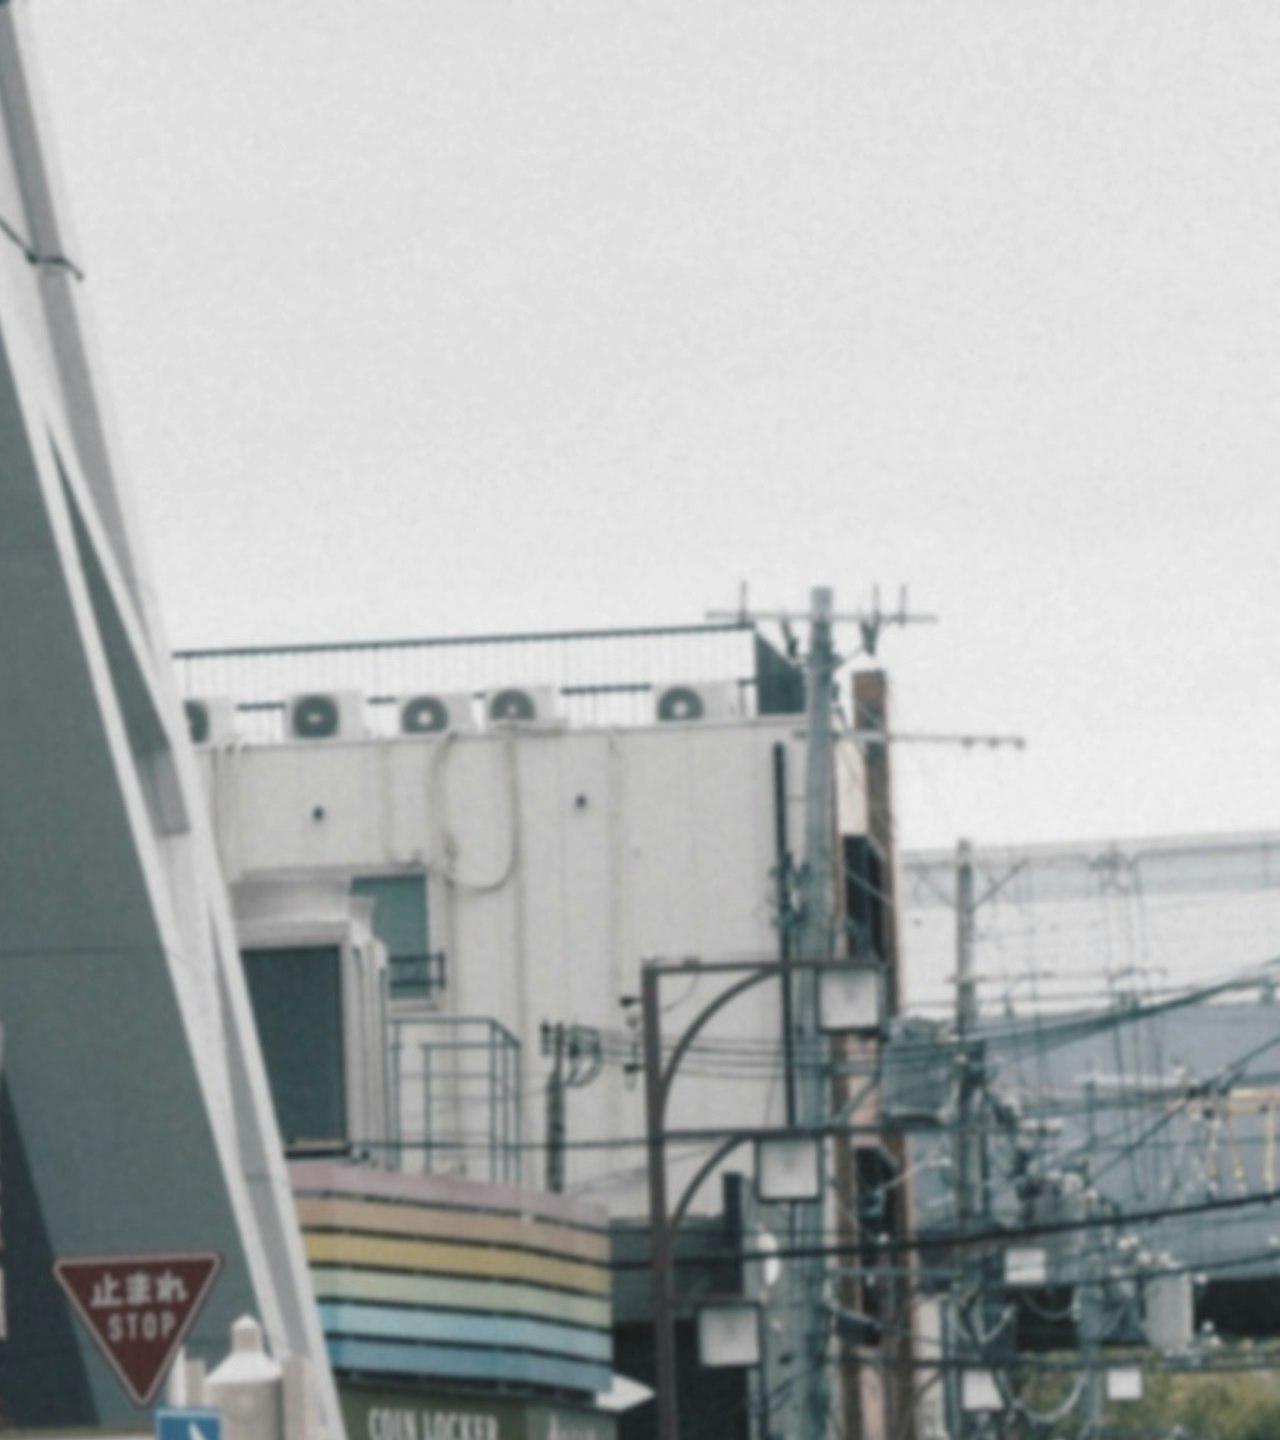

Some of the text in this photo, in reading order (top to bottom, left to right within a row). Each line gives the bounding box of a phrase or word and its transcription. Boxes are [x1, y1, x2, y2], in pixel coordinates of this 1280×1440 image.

[90, 1270, 188, 1308] 止まれ
[108, 1312, 176, 1342] STOP
